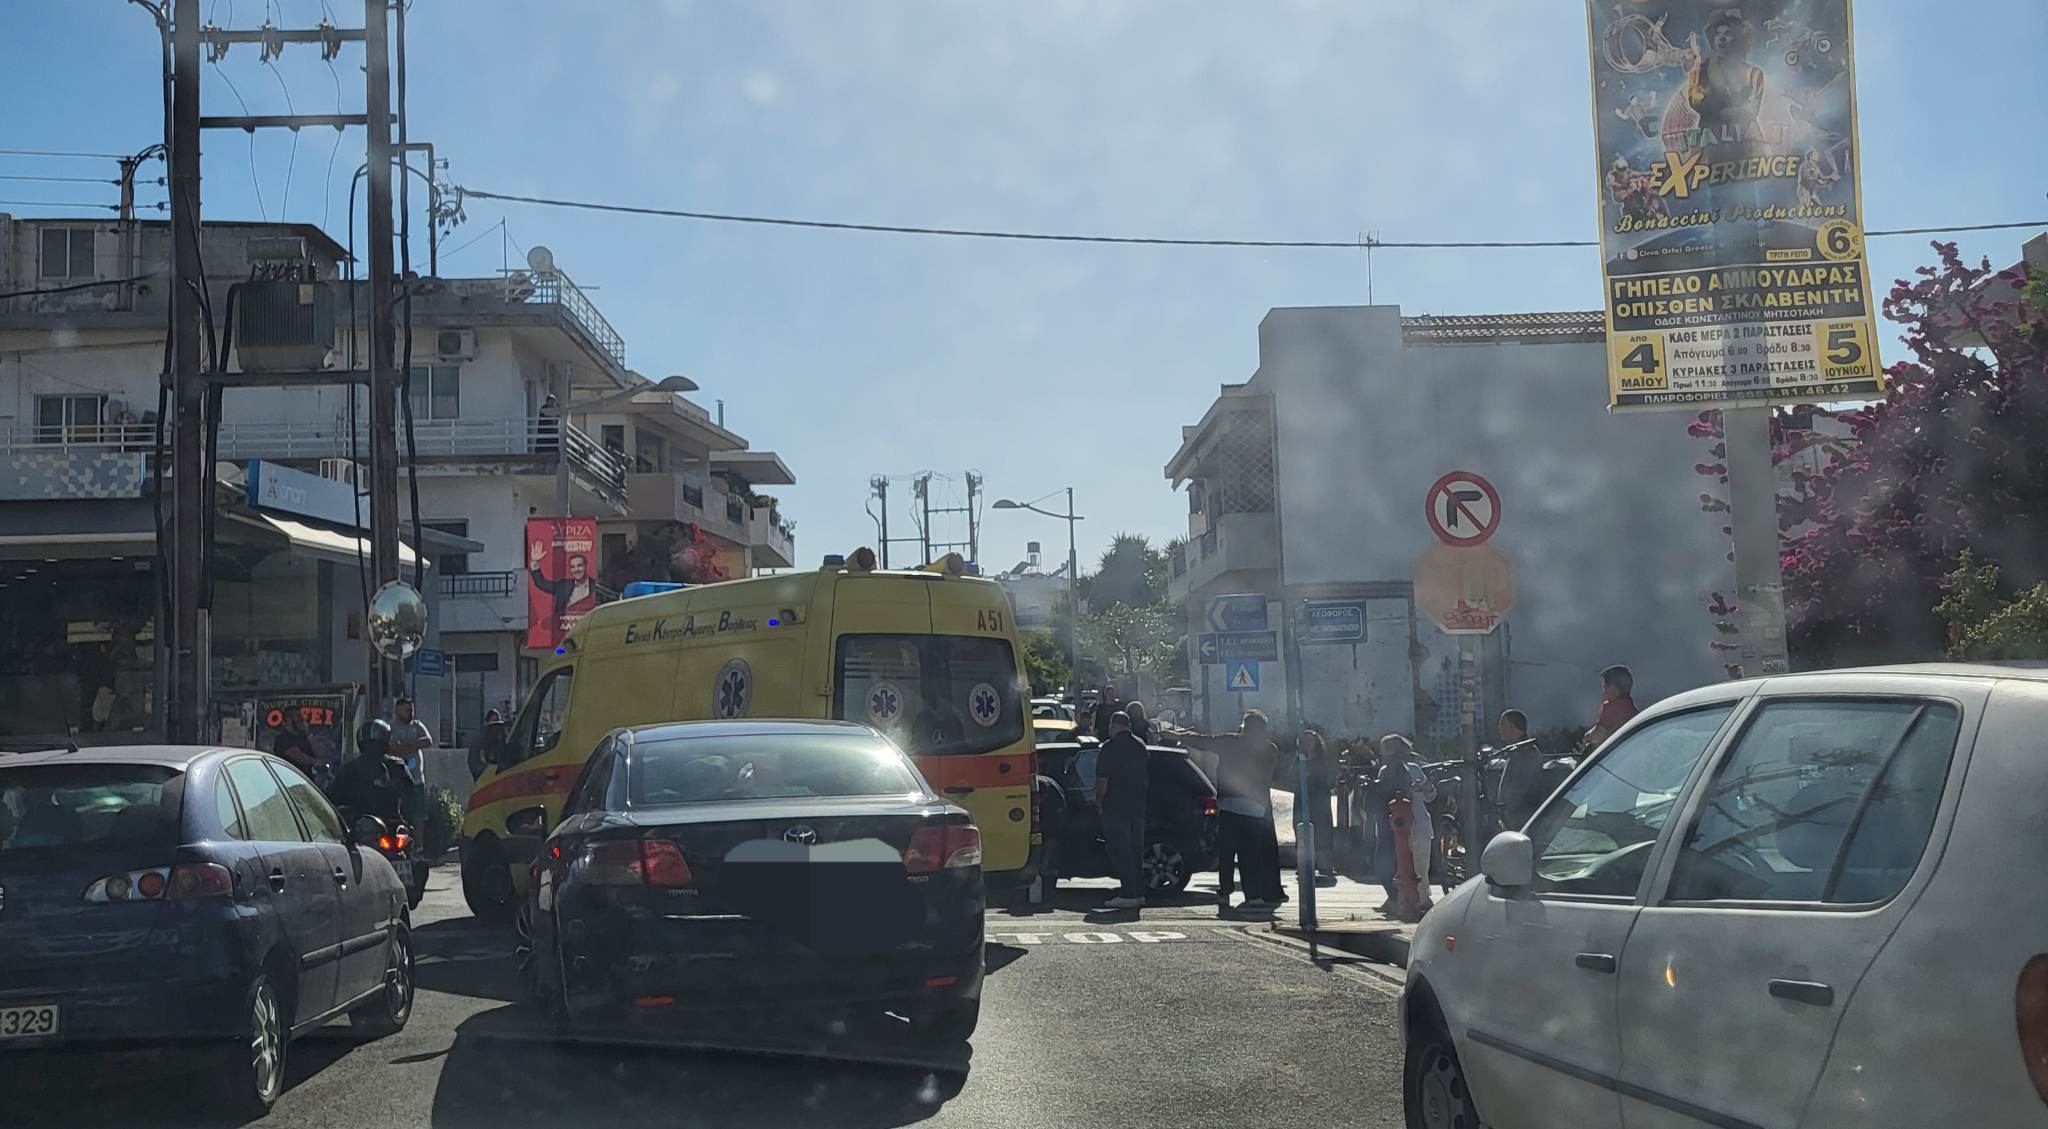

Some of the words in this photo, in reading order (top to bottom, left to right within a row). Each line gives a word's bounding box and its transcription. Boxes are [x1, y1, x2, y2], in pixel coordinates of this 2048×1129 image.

[1650, 152, 1800, 198] EXPERIENCE
[1614, 208, 1719, 233] Bonaccini
[1724, 203, 1847, 222] Productions
[1615, 276, 1701, 299] ΓΗΠΕΔΟ
[1708, 266, 1858, 291] ΑΜΜΟΥΔΑΡΑΣ
[1616, 297, 1713, 318] ΟΠΙΣΘΕΝ
[1721, 288, 1860, 310] ΣΚΛΑΒΕΝΙΤΗ
[1654, 316, 1683, 326] ΟΔΟΣ
[1684, 310, 1762, 325] ΚΩΝΣΤΑΝΤΙΝΟΥ
[1763, 307, 1824, 318] ΜΗΤΣΟΤΑΚΗ
[1669, 332, 1698, 343] ΚΑΘΕ
[1701, 328, 1731, 341] ΜΕΡΑ
[1733, 327, 1740, 338] 2
[1743, 323, 1813, 338] ΠΑΡΑΣΤΑΣΕΙΣ
[1673, 347, 1725, 361] Απόγευμα
[1756, 342, 1788, 356] Βράδυ
[1790, 342, 1811, 353] 8:30
[1827, 330, 1863, 365] 5
[1621, 343, 1660, 374] 4
[1672, 365, 1727, 377] ΚΥΡΙΑΚΕΣ
[1730, 364, 1737, 375] 3
[1740, 359, 1816, 373] ΠΑΡΑΣΤΑΣΕΙΣ
[1825, 365, 1867, 378] ΙΟΥΝΙΟΥ
[1644, 392, 1729, 403] ΠΛΗΡΟΦΟΡΙΕΣ
[267, 706, 334, 727] OFEI
[985, 931, 1187, 944] TOP
[0, 1008, 54, 1035] 329
